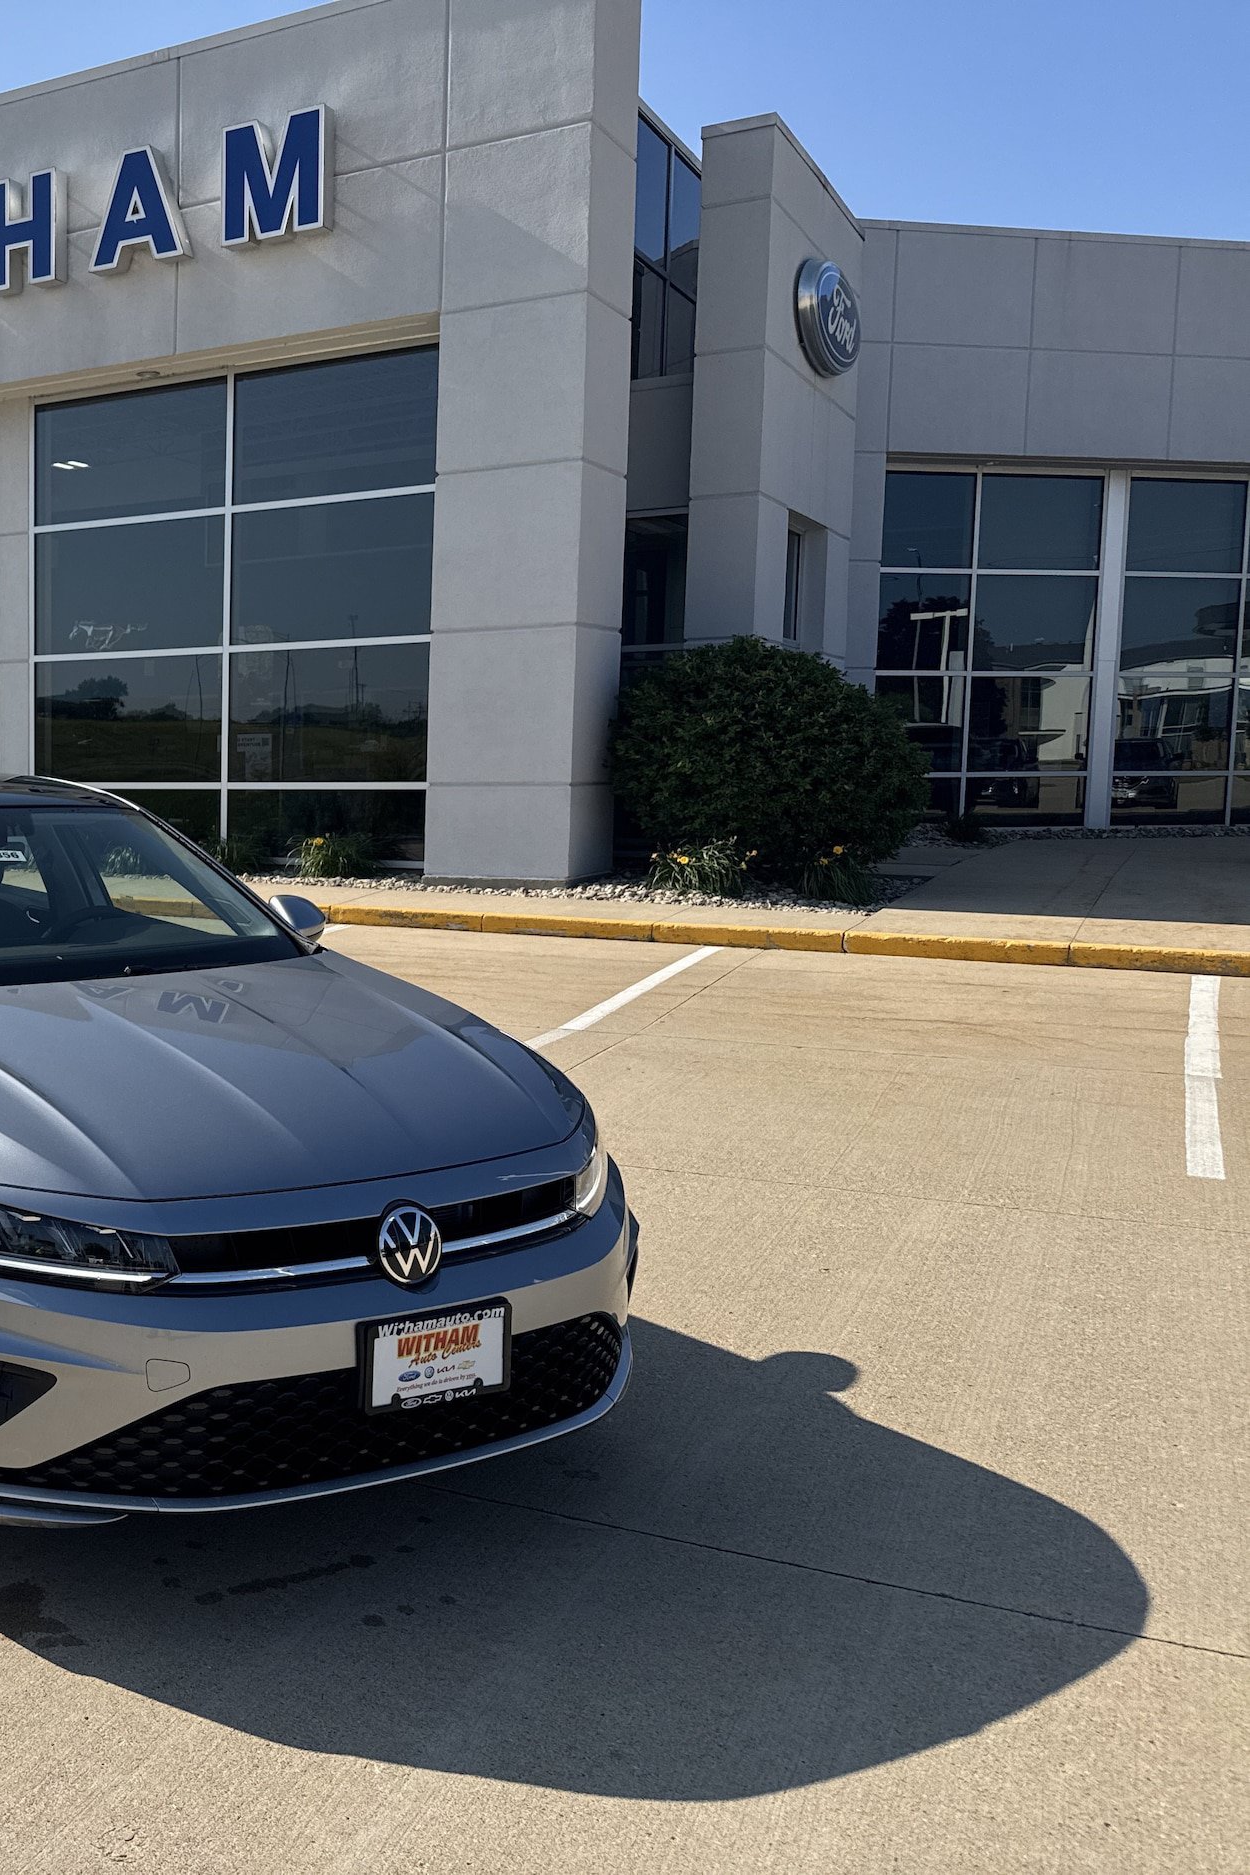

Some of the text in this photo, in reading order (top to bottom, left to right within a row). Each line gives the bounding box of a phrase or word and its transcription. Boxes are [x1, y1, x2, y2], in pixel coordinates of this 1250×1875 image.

[397, 1323, 481, 1359] WITHAM
[408, 1340, 482, 1368] Auto Centers
[396, 1382, 424, 1392] Everything
[443, 1375, 460, 1383] driven
